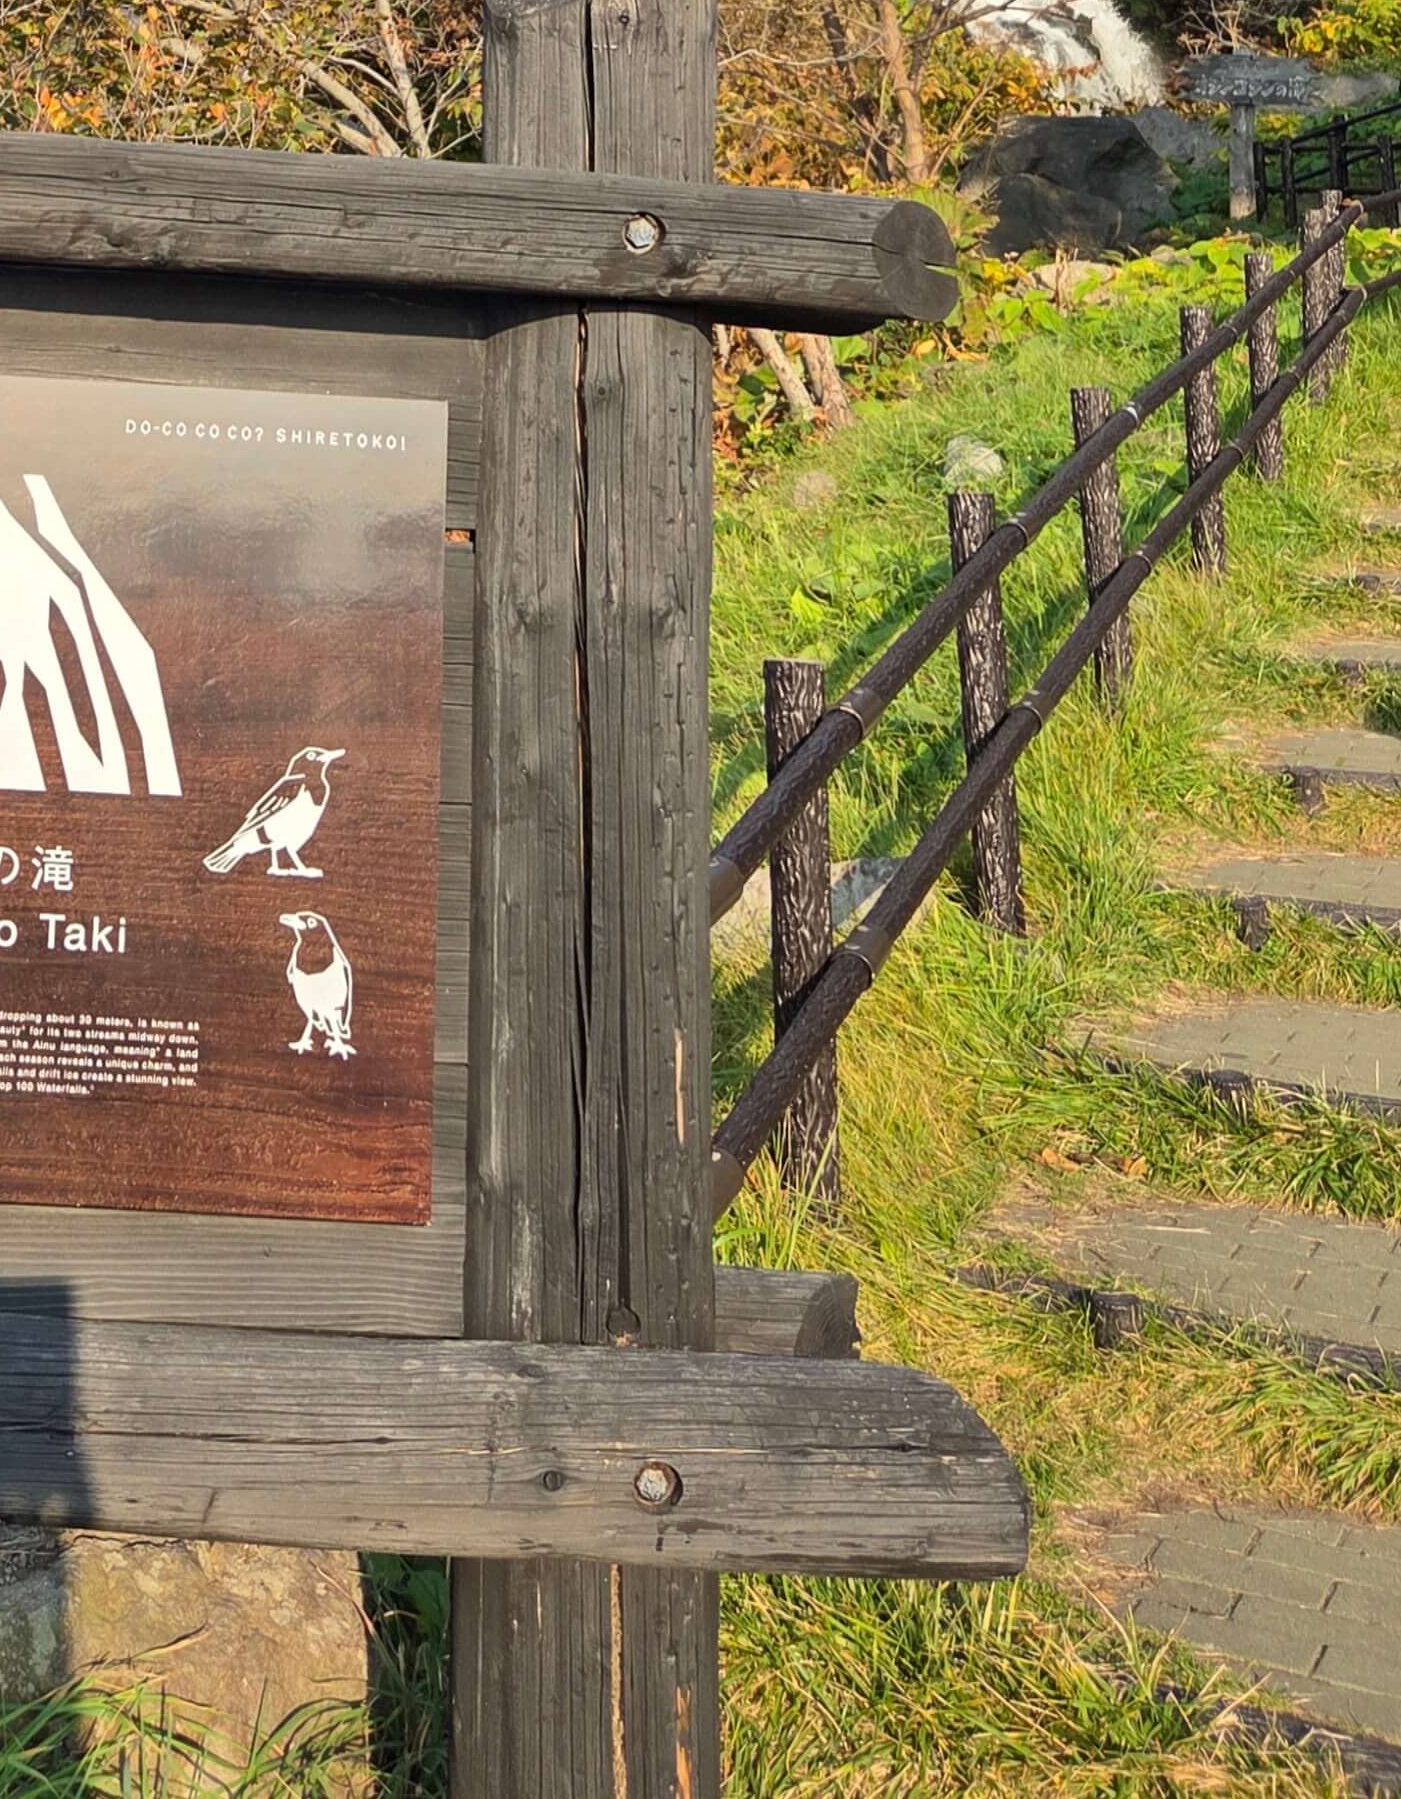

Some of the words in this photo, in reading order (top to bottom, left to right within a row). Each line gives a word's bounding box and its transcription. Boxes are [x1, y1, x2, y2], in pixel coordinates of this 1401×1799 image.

[40, 914, 125, 952] Taki
[46, 1014, 74, 1024] about
[79, 1014, 91, 1024] 30
[96, 1017, 133, 1027] meters,
[152, 1019, 183, 1029] known
[188, 1022, 199, 1031] as
[30, 1026, 43, 1036] for
[64, 1028, 81, 1038] two
[86, 1030, 124, 1040] streams
[128, 1032, 165, 1044] midway
[13, 1040, 28, 1049] the
[33, 1040, 55, 1050] Ainu
[61, 1042, 108, 1055] language,
[165, 1049, 172, 1057] a
[177, 1048, 198, 1058] land
[19, 1055, 54, 1064] season
[57, 1057, 93, 1066] reveals
[96, 1059, 102, 1067] a
[106, 1059, 139, 1069] unique
[142, 1060, 175, 1071] charm,
[179, 1063, 197, 1072] and
[17, 1069, 36, 1078] and
[39, 1069, 60, 1079] drift
[64, 1071, 78, 1080] ice
[82, 1072, 113, 1082] create
[116, 1074, 122, 1082] a
[126, 1074, 168, 1086] stunning
[16, 1081, 34, 1092] 100
